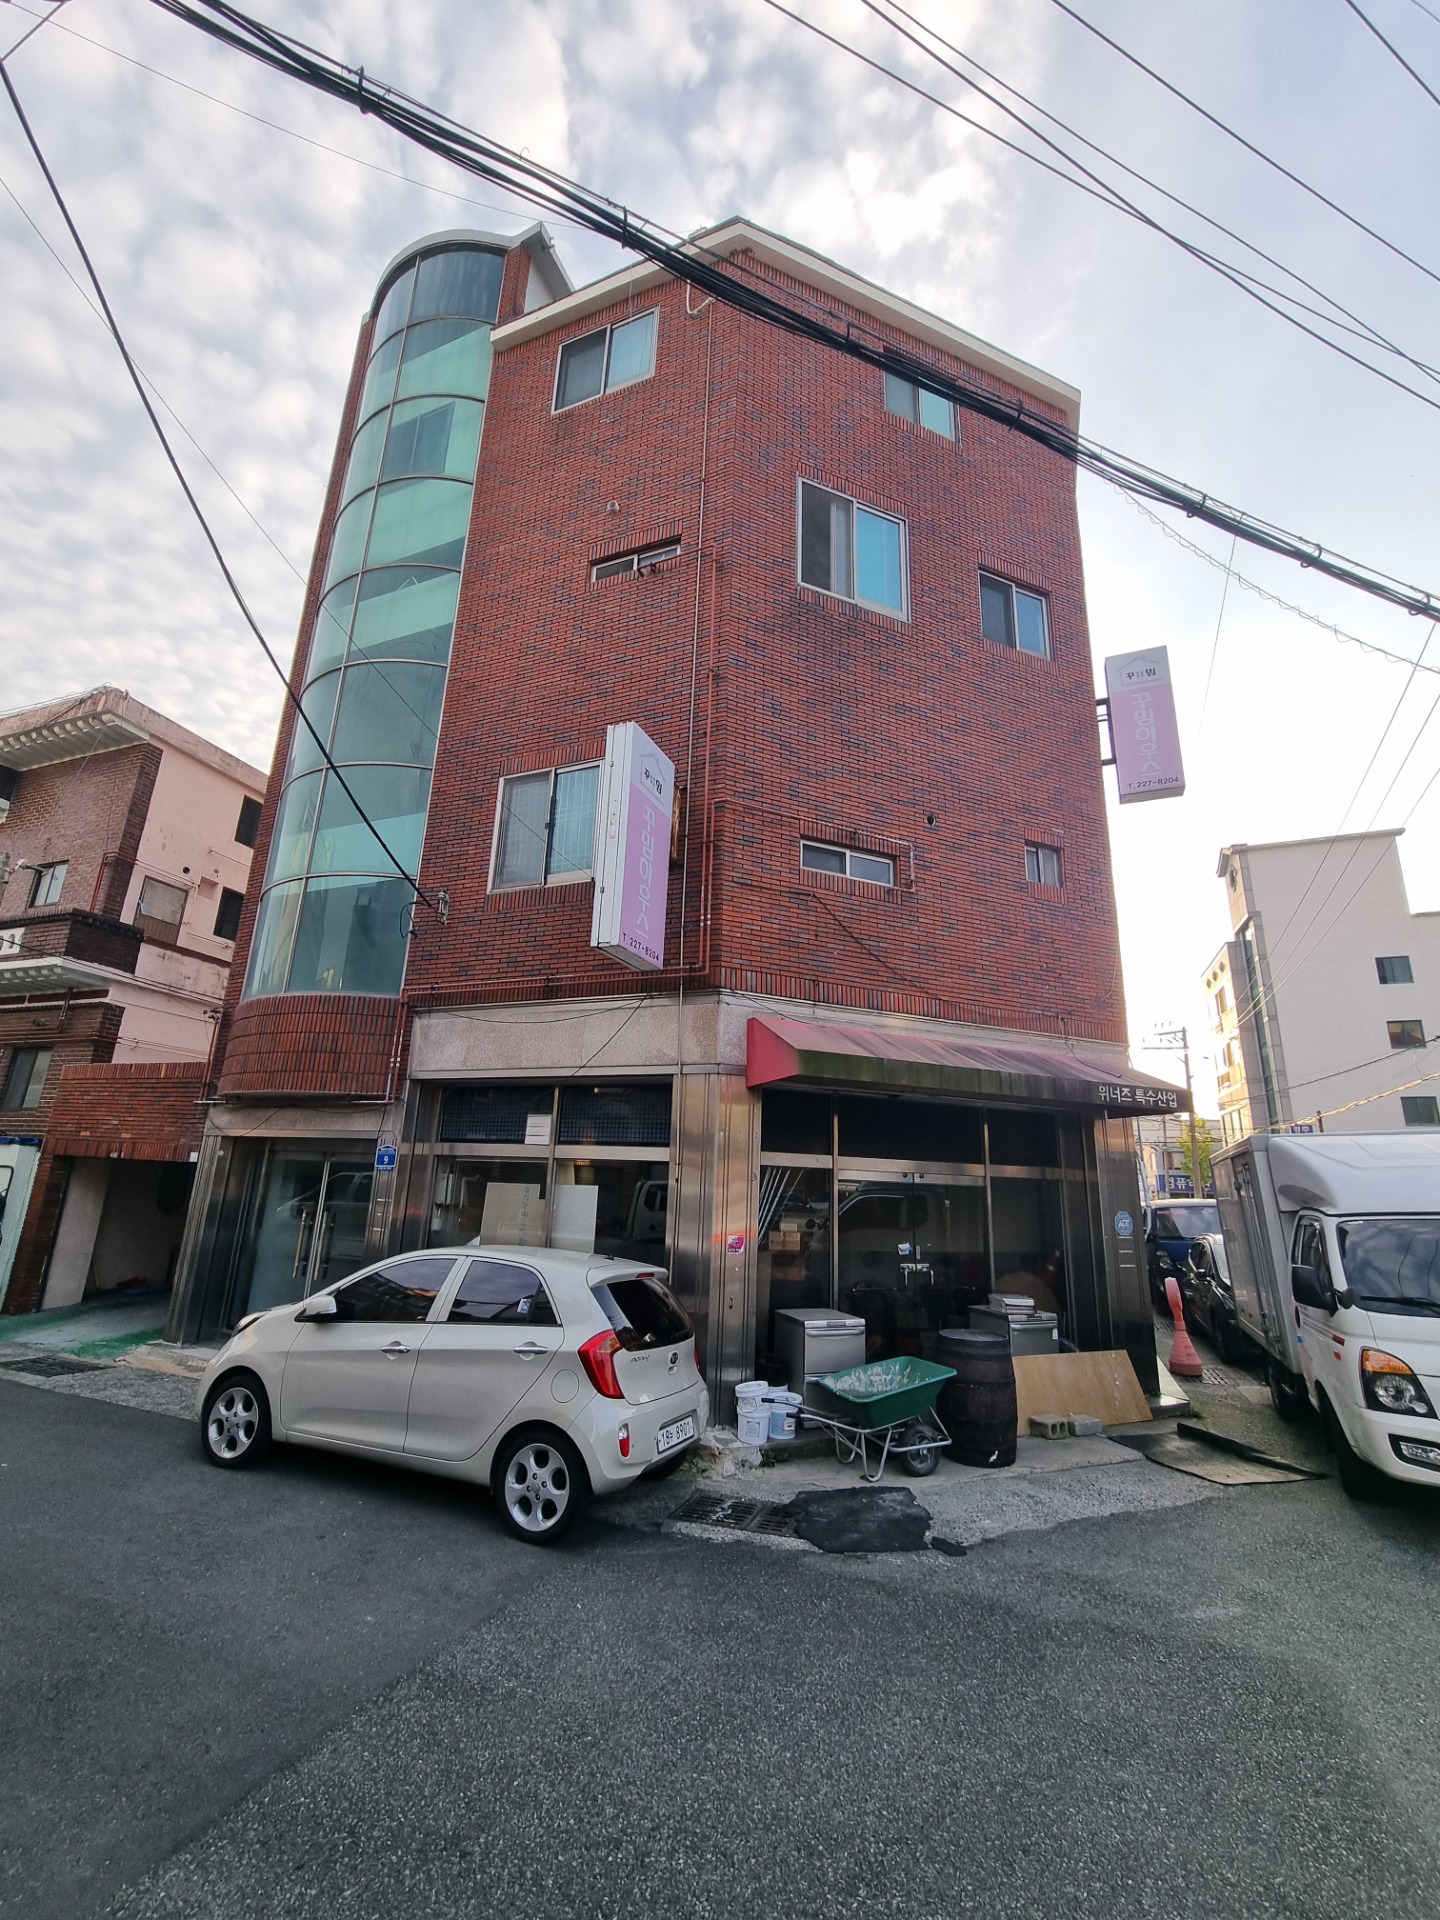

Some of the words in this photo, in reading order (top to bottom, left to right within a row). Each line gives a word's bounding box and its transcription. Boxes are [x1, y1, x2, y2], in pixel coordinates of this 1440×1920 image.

[1098, 1085, 1133, 1103] 위너즈
[1134, 1088, 1178, 1108] 특수산업
[383, 1155, 389, 1164] 9
